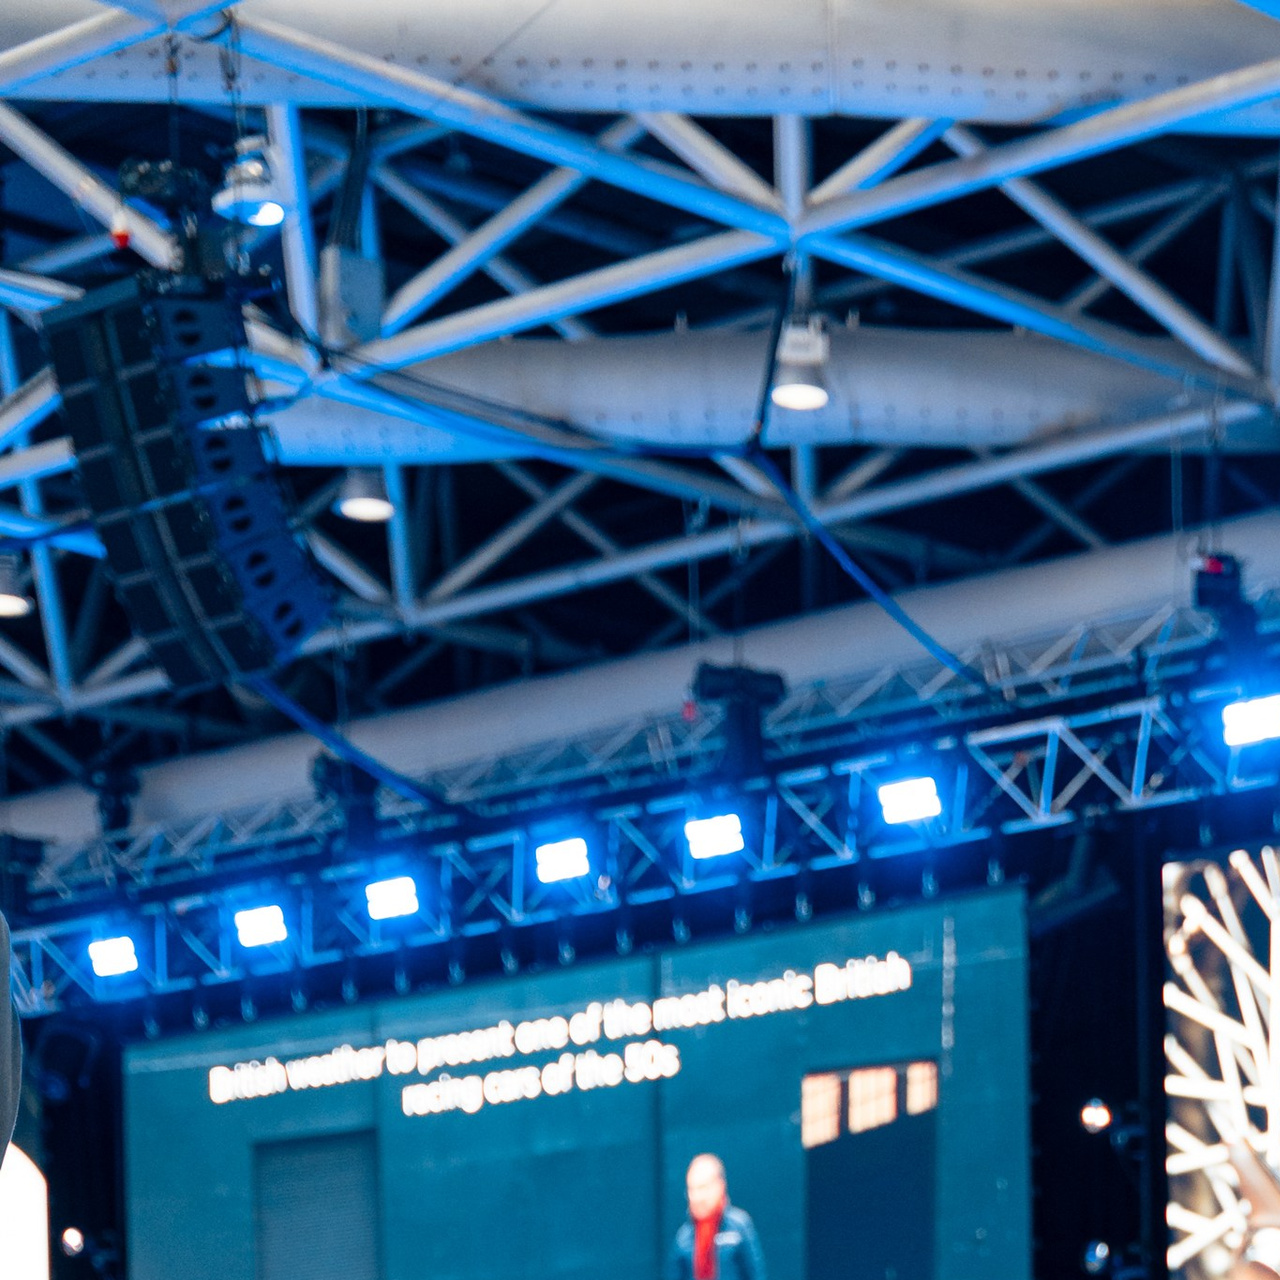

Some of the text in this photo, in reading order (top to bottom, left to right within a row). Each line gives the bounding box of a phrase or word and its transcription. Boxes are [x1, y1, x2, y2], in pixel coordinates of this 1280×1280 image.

[208, 1056, 287, 1104] British
[385, 1038, 417, 1075] to
[417, 1019, 515, 1076] present
[514, 1015, 569, 1054] one
[568, 1001, 603, 1046] of
[603, 998, 652, 1040] the
[652, 984, 727, 1032] most
[726, 969, 814, 1019] iconic
[814, 951, 912, 1005] British
[402, 1073, 484, 1117] racing
[483, 1066, 542, 1105] cars
[541, 1052, 575, 1096] of
[574, 1049, 624, 1091] the
